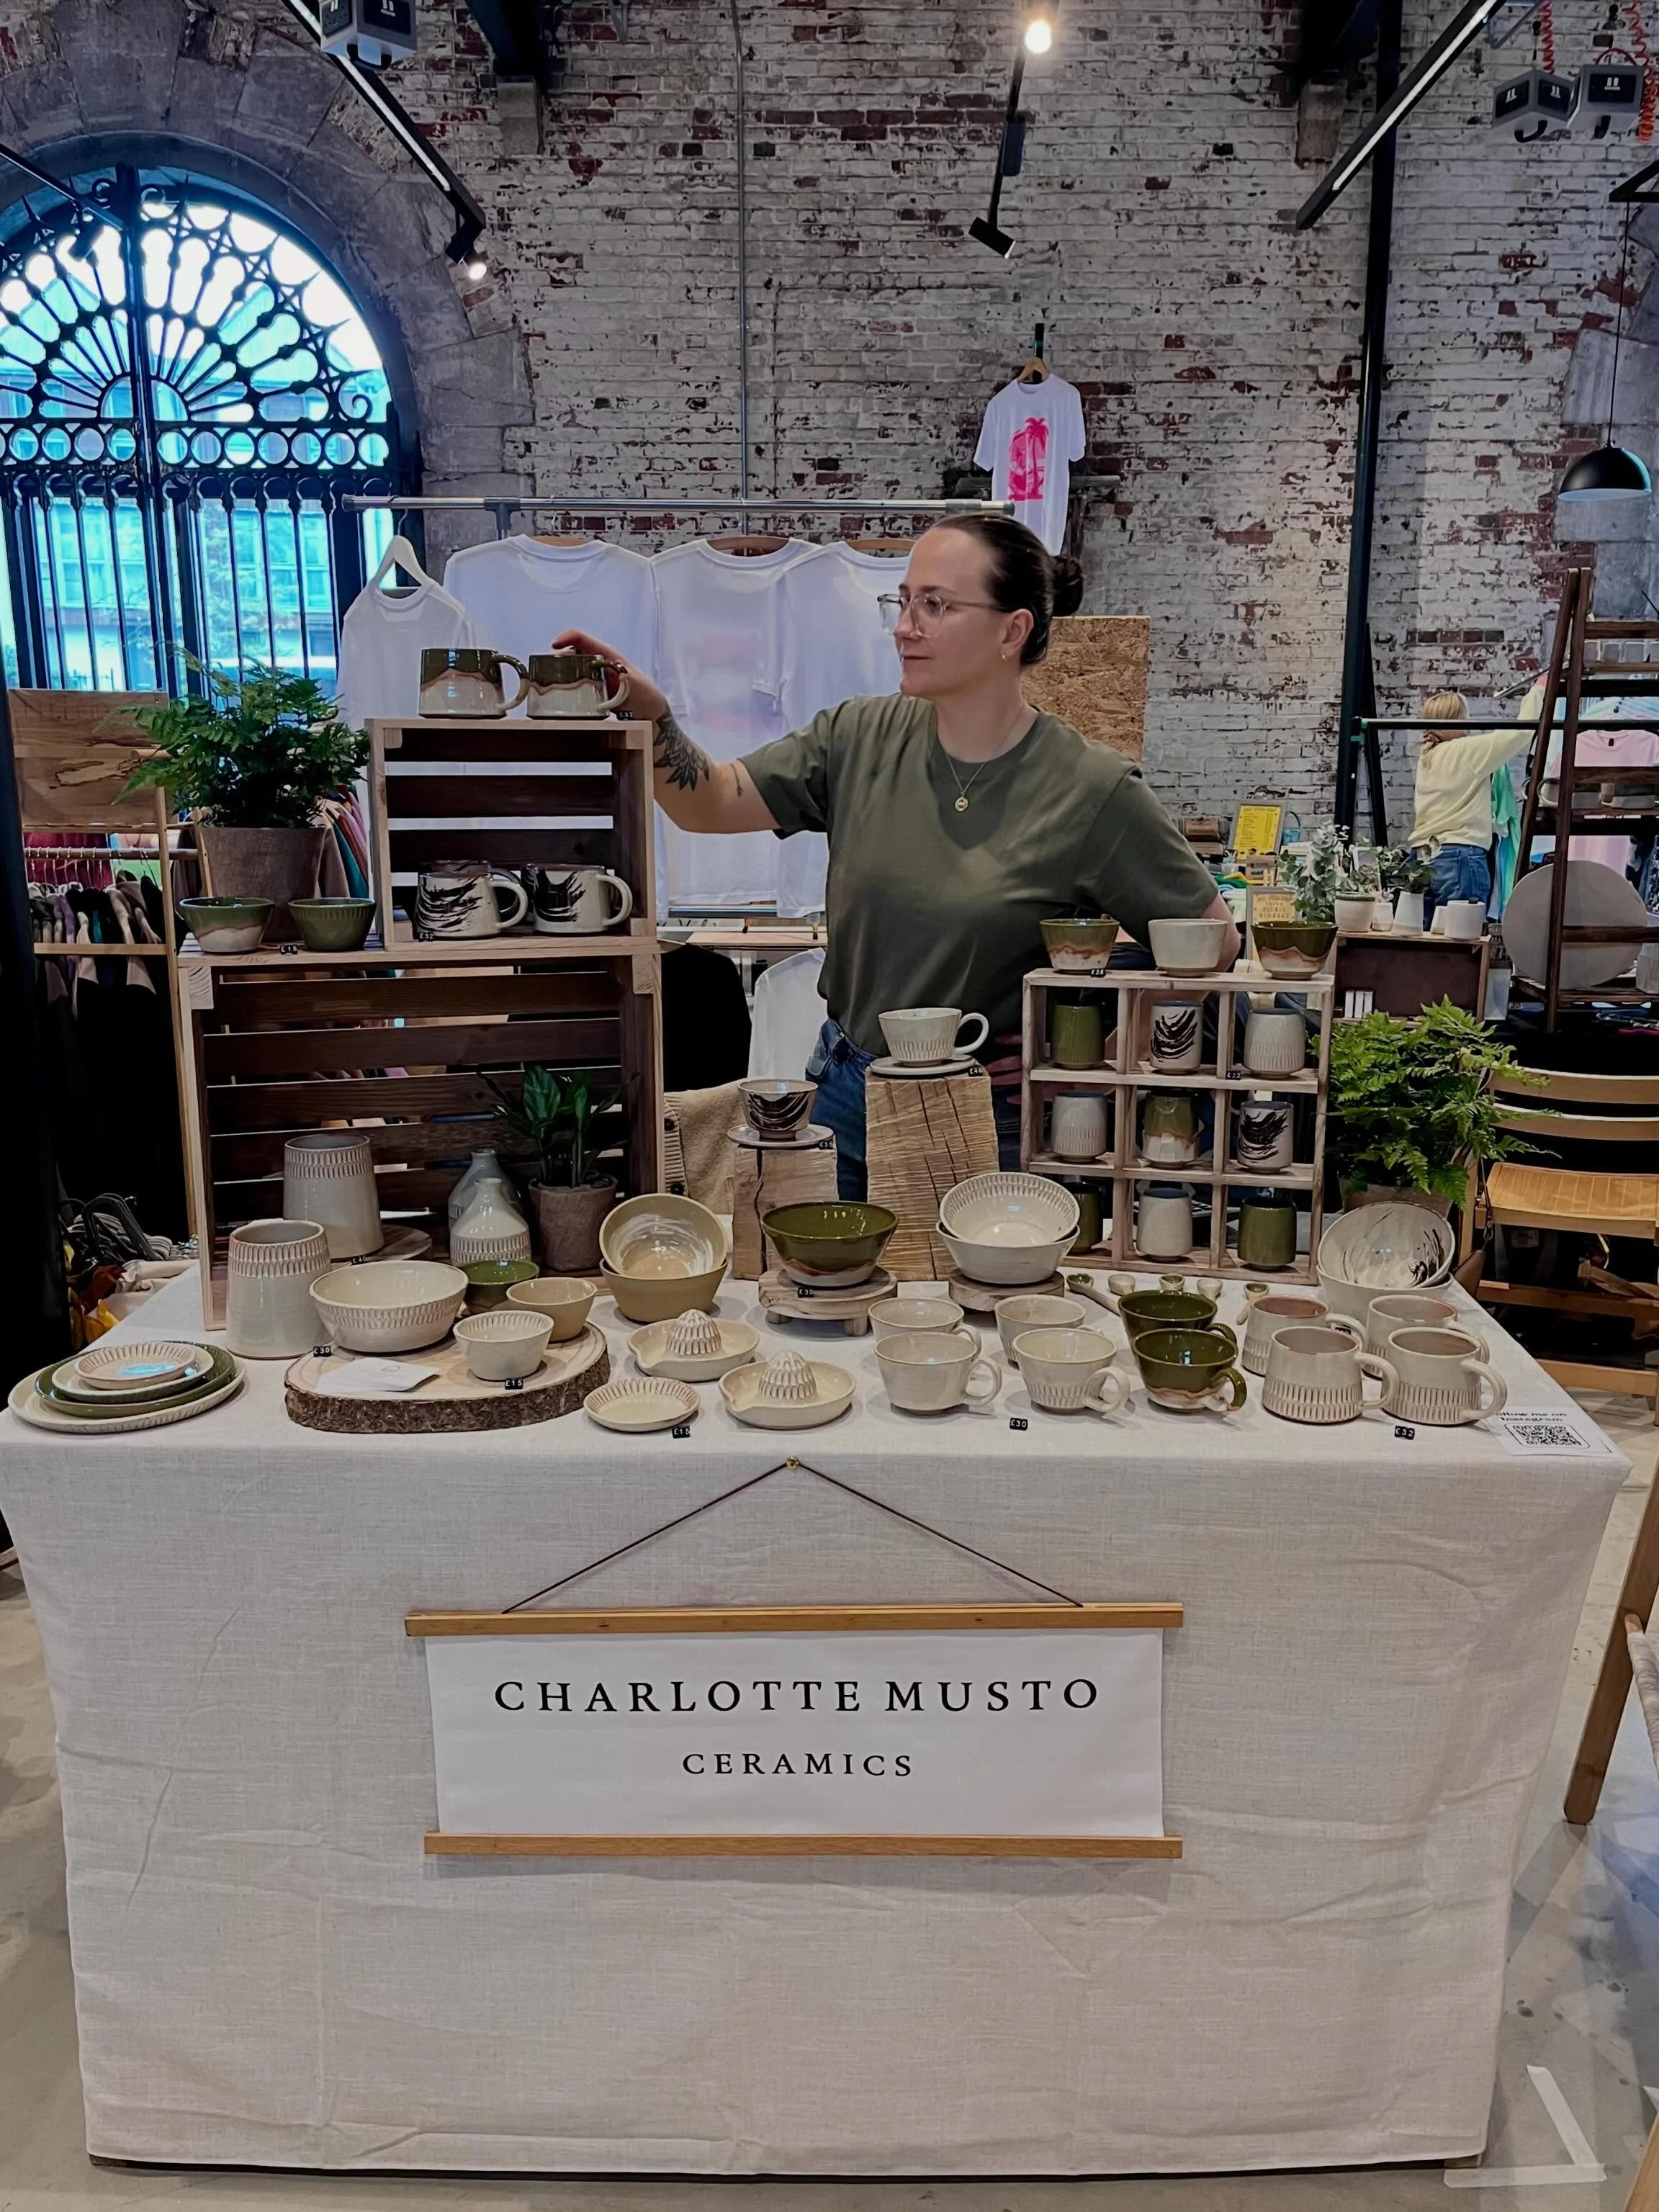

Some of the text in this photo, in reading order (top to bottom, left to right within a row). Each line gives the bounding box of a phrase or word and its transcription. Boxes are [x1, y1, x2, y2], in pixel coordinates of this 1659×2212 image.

[1011, 1419, 1027, 1428] £30
[1395, 1427, 1413, 1437] £32
[494, 1678, 1098, 1713] CHARLOTTE MUSTO
[682, 1752, 912, 1778] CERAMICS
